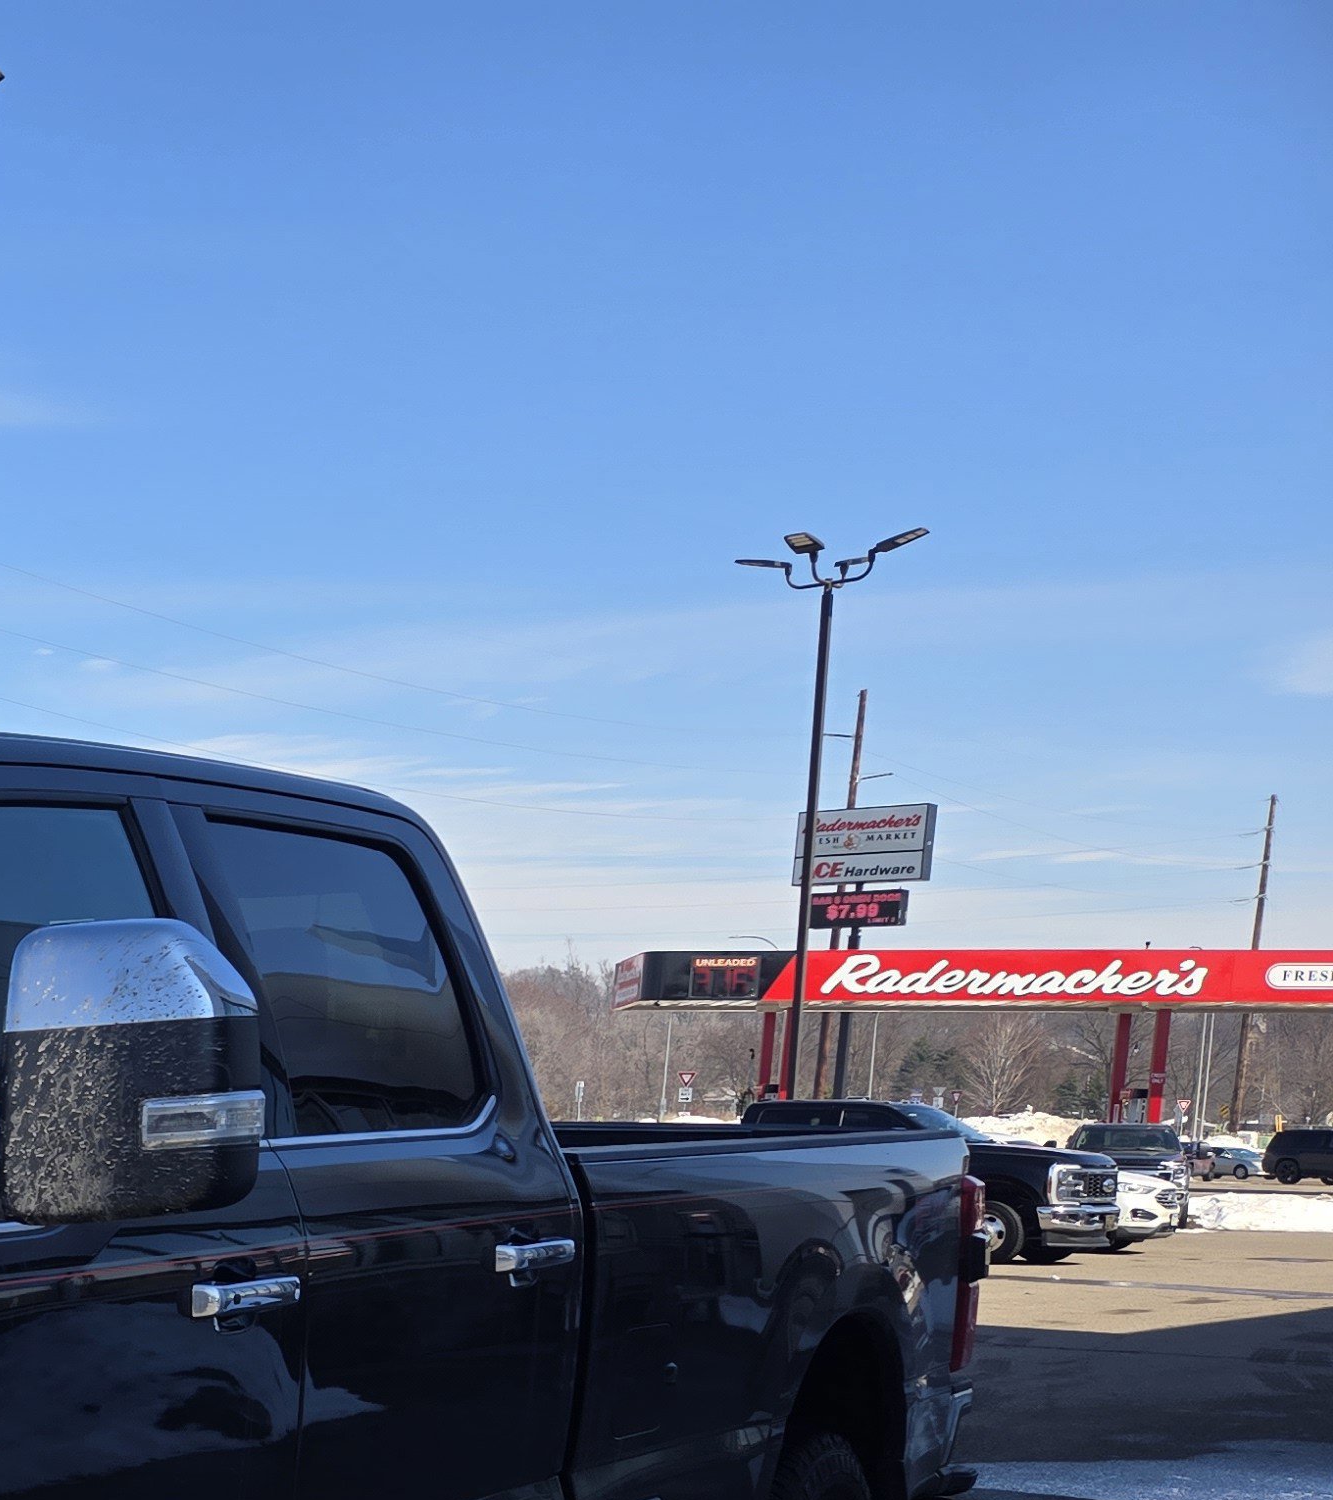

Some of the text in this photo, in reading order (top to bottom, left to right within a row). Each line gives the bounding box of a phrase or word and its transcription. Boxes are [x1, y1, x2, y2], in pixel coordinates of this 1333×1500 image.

[865, 832, 917, 842] MARKET
[843, 865, 916, 878] Hardware
[826, 902, 880, 921] $7.99
[695, 957, 757, 968] UNLEADED
[820, 953, 1208, 996] Radermacher's
[1282, 970, 1333, 982] FRES
